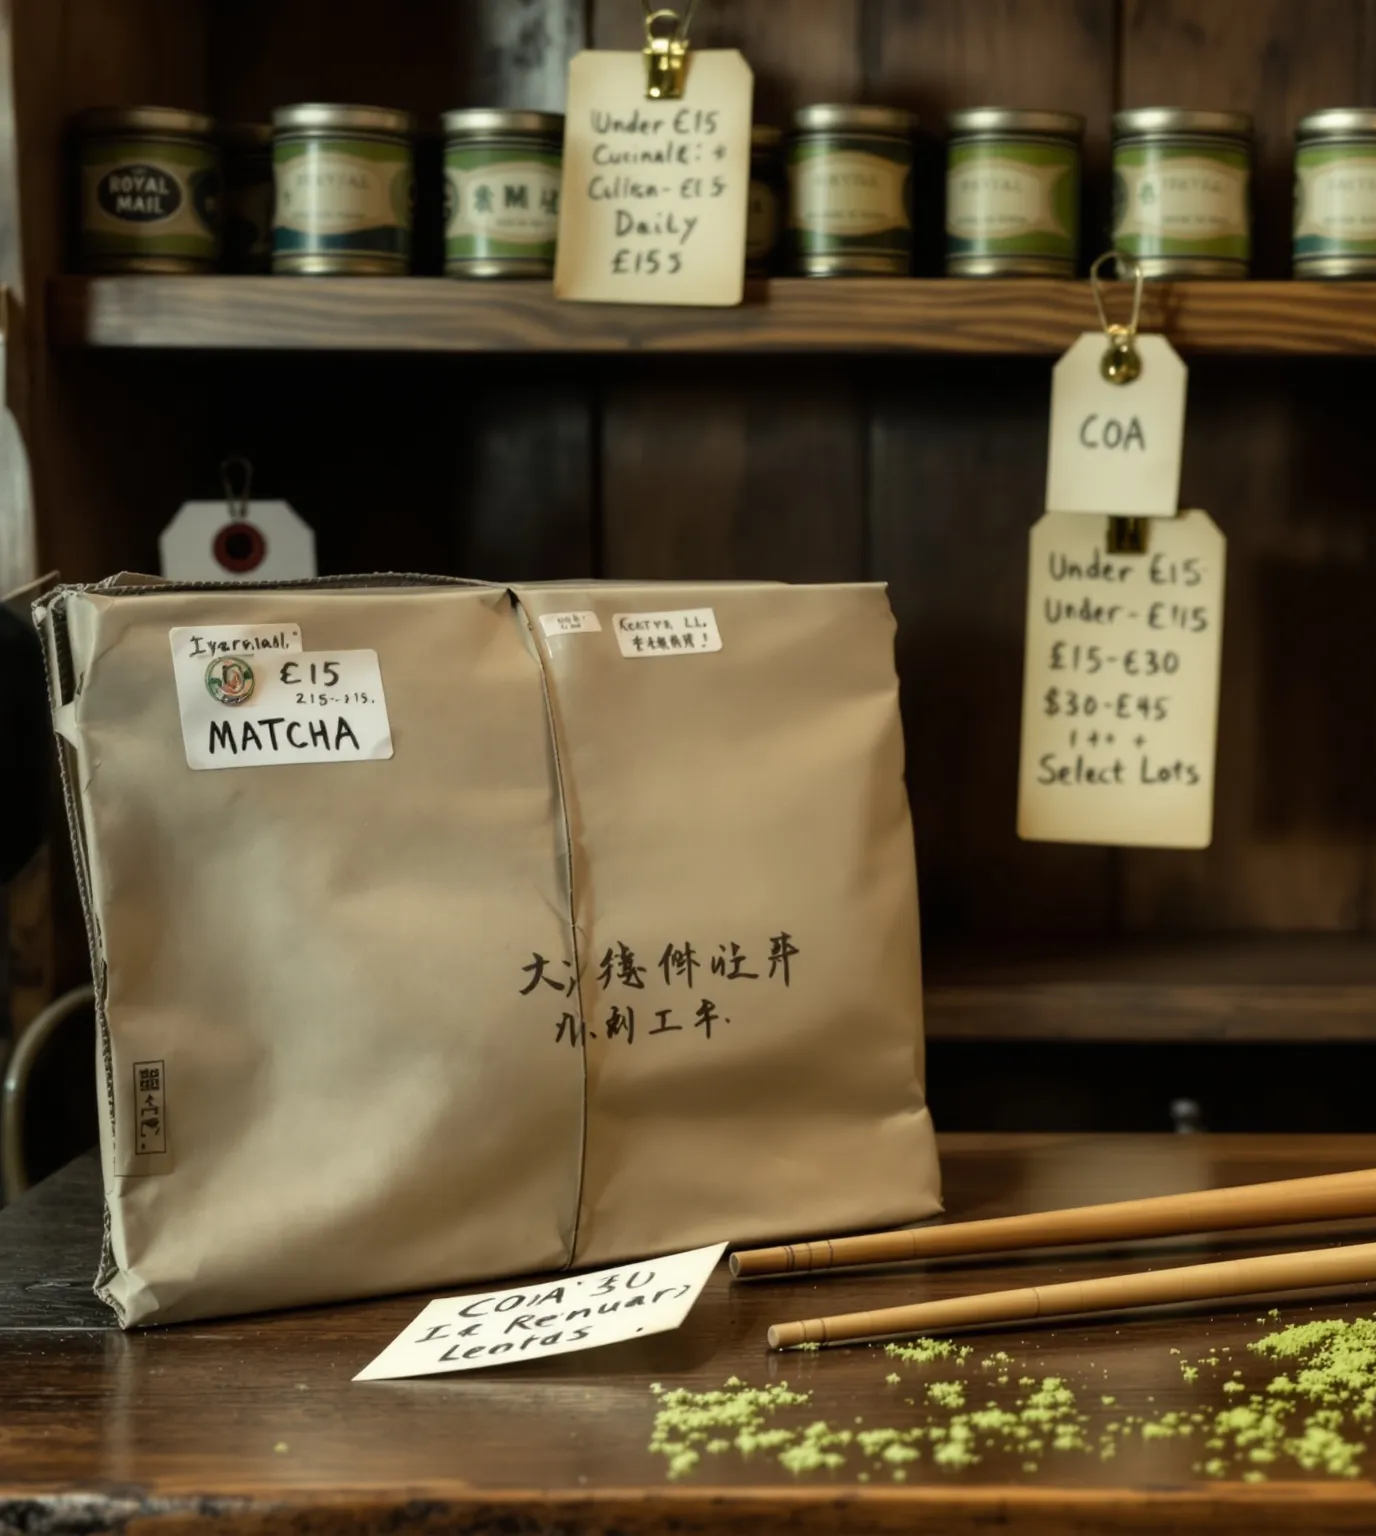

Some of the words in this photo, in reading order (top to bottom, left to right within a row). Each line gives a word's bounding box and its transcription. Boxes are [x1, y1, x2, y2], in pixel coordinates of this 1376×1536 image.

[590, 108, 665, 135] Under
[109, 175, 170, 195] ROYAL
[116, 195, 166, 214] MAIL
[614, 209, 698, 246] Daily
[1079, 413, 1147, 452] COA
[1048, 546, 1133, 583] Under
[208, 716, 361, 755] MATCHA
[1036, 752, 1125, 786] Select
[1140, 754, 1201, 786] Lots
